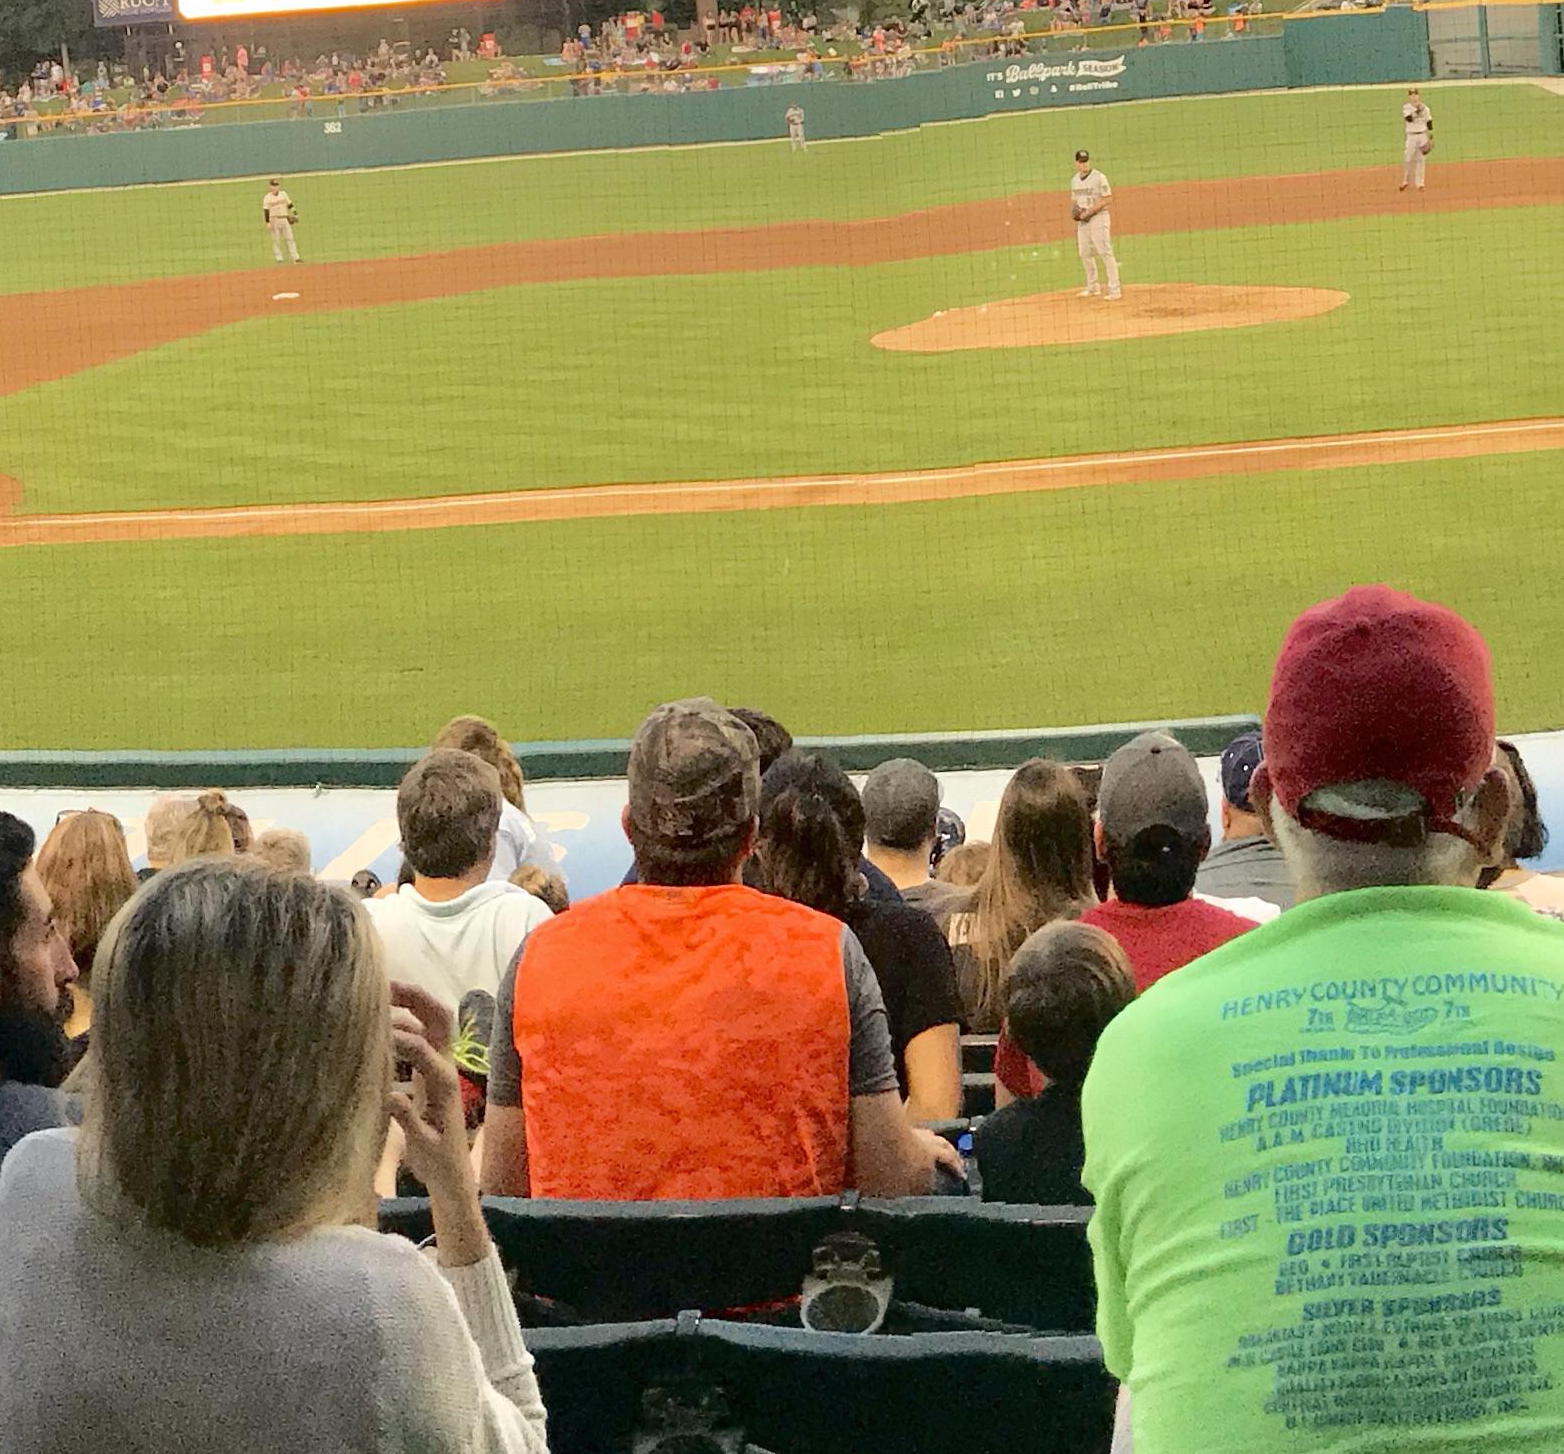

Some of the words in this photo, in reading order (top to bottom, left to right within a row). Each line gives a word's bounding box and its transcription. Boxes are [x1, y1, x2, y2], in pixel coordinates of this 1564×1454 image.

[1005, 60, 1077, 84] Ballpark
[1222, 987, 1307, 1020] HENRY
[1310, 976, 1408, 1002] COUNTY
[1412, 973, 1564, 1000] COMMUNITY
[1231, 1051, 1296, 1078] Special
[1298, 1046, 1355, 1065] Thanks
[1359, 1046, 1381, 1060] To
[1245, 1069, 1383, 1113] PLATINUM
[1389, 1066, 1543, 1096] SPONSORS
[1219, 1115, 1264, 1143] HENRY
[1268, 1105, 1323, 1129] COUNTY
[1273, 1156, 1333, 1184] COUNTY
[1274, 1180, 1319, 1205] FIRST
[1323, 1172, 1443, 1197] PRESBYTERIAN
[1449, 1170, 1517, 1189] CHURCH
[1286, 1223, 1357, 1257] GOLD
[1362, 1216, 1510, 1249] SPONSORS
[1381, 1286, 1503, 1318] SPONSORS
